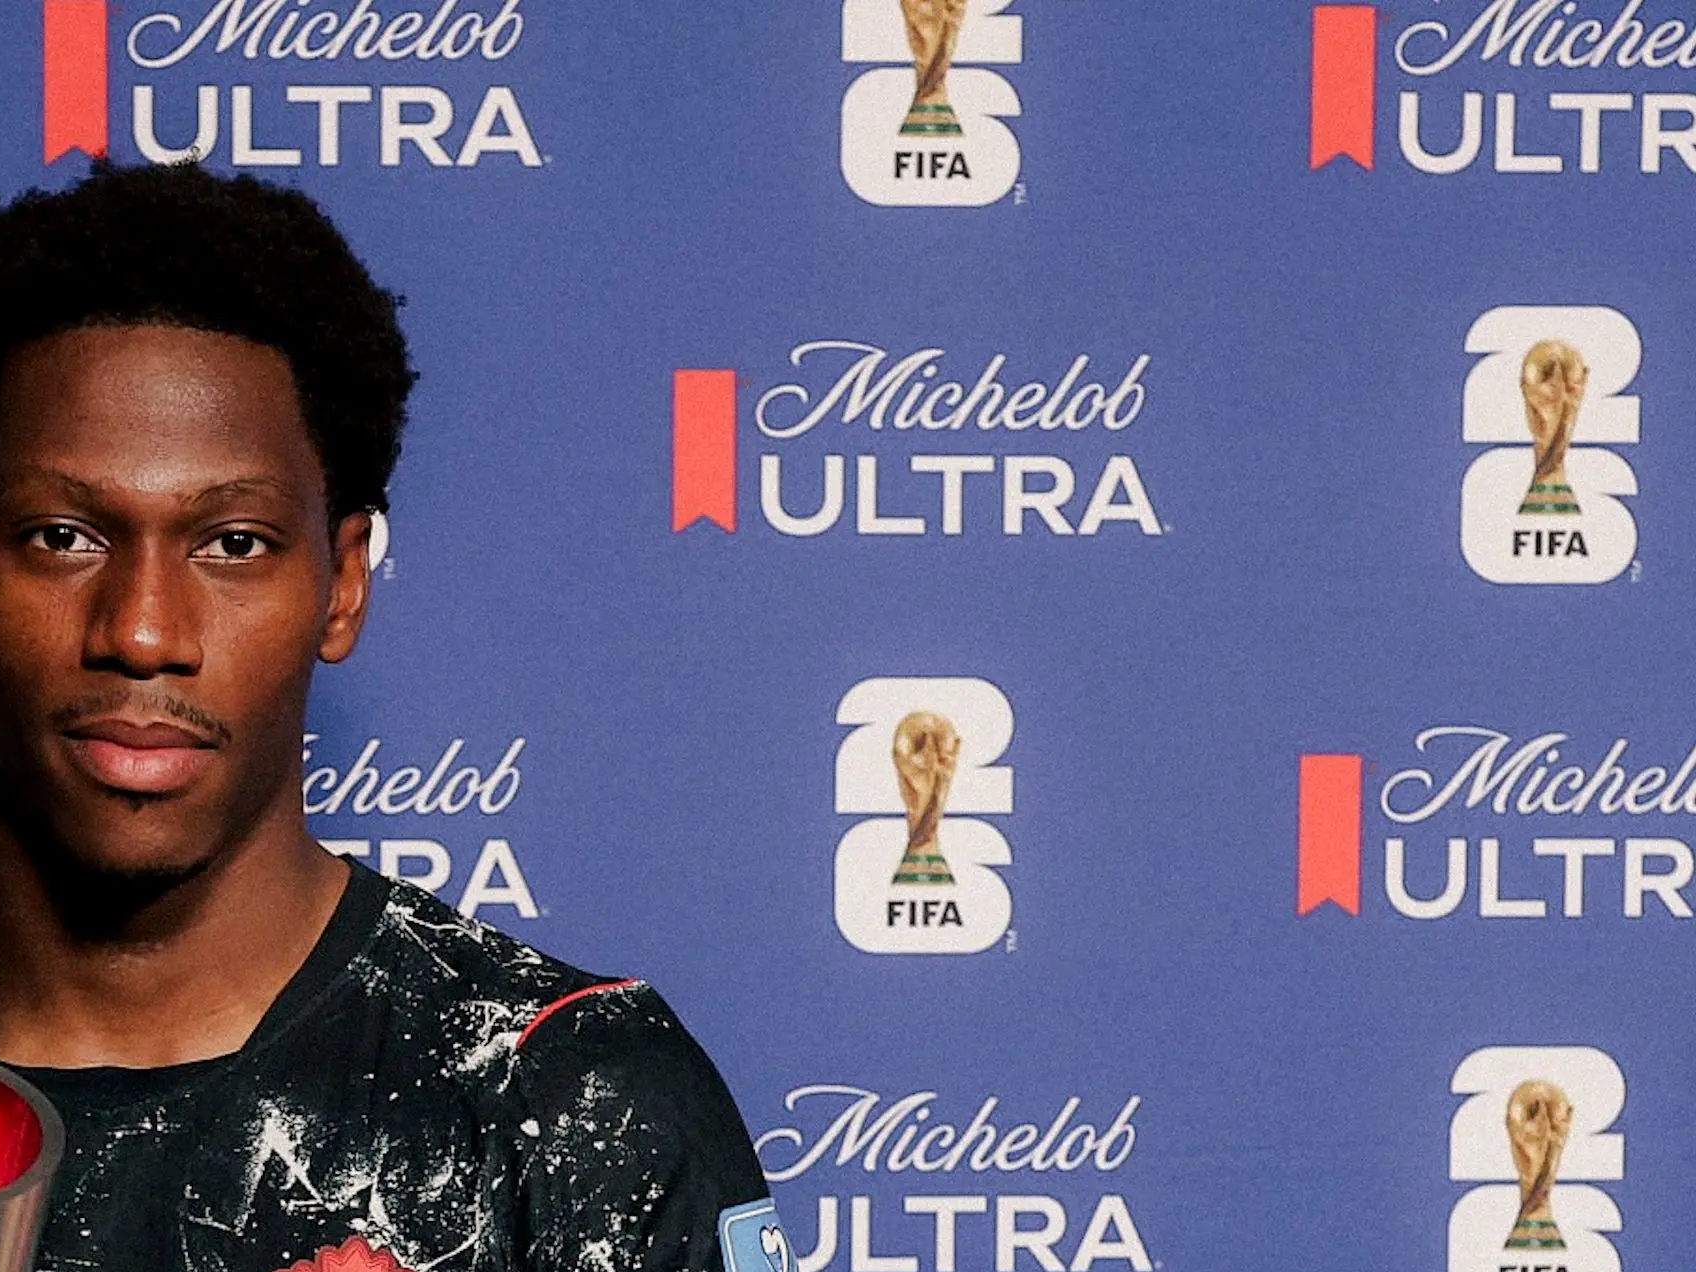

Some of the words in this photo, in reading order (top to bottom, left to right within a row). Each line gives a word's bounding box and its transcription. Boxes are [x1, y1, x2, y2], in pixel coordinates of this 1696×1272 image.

[133, 85, 542, 167] ULTRA
[895, 152, 970, 179] FIFA
[1399, 91, 1696, 174] ULTR
[755, 340, 1150, 438] Michelob
[760, 455, 1162, 536] ULTRA
[1513, 531, 1588, 556] FIFA
[303, 734, 525, 814] chelob
[1380, 726, 1696, 823] Michel
[888, 901, 962, 927] FIFA
[1385, 838, 1696, 919] ULTR
[754, 1085, 1141, 1181] Michelob
